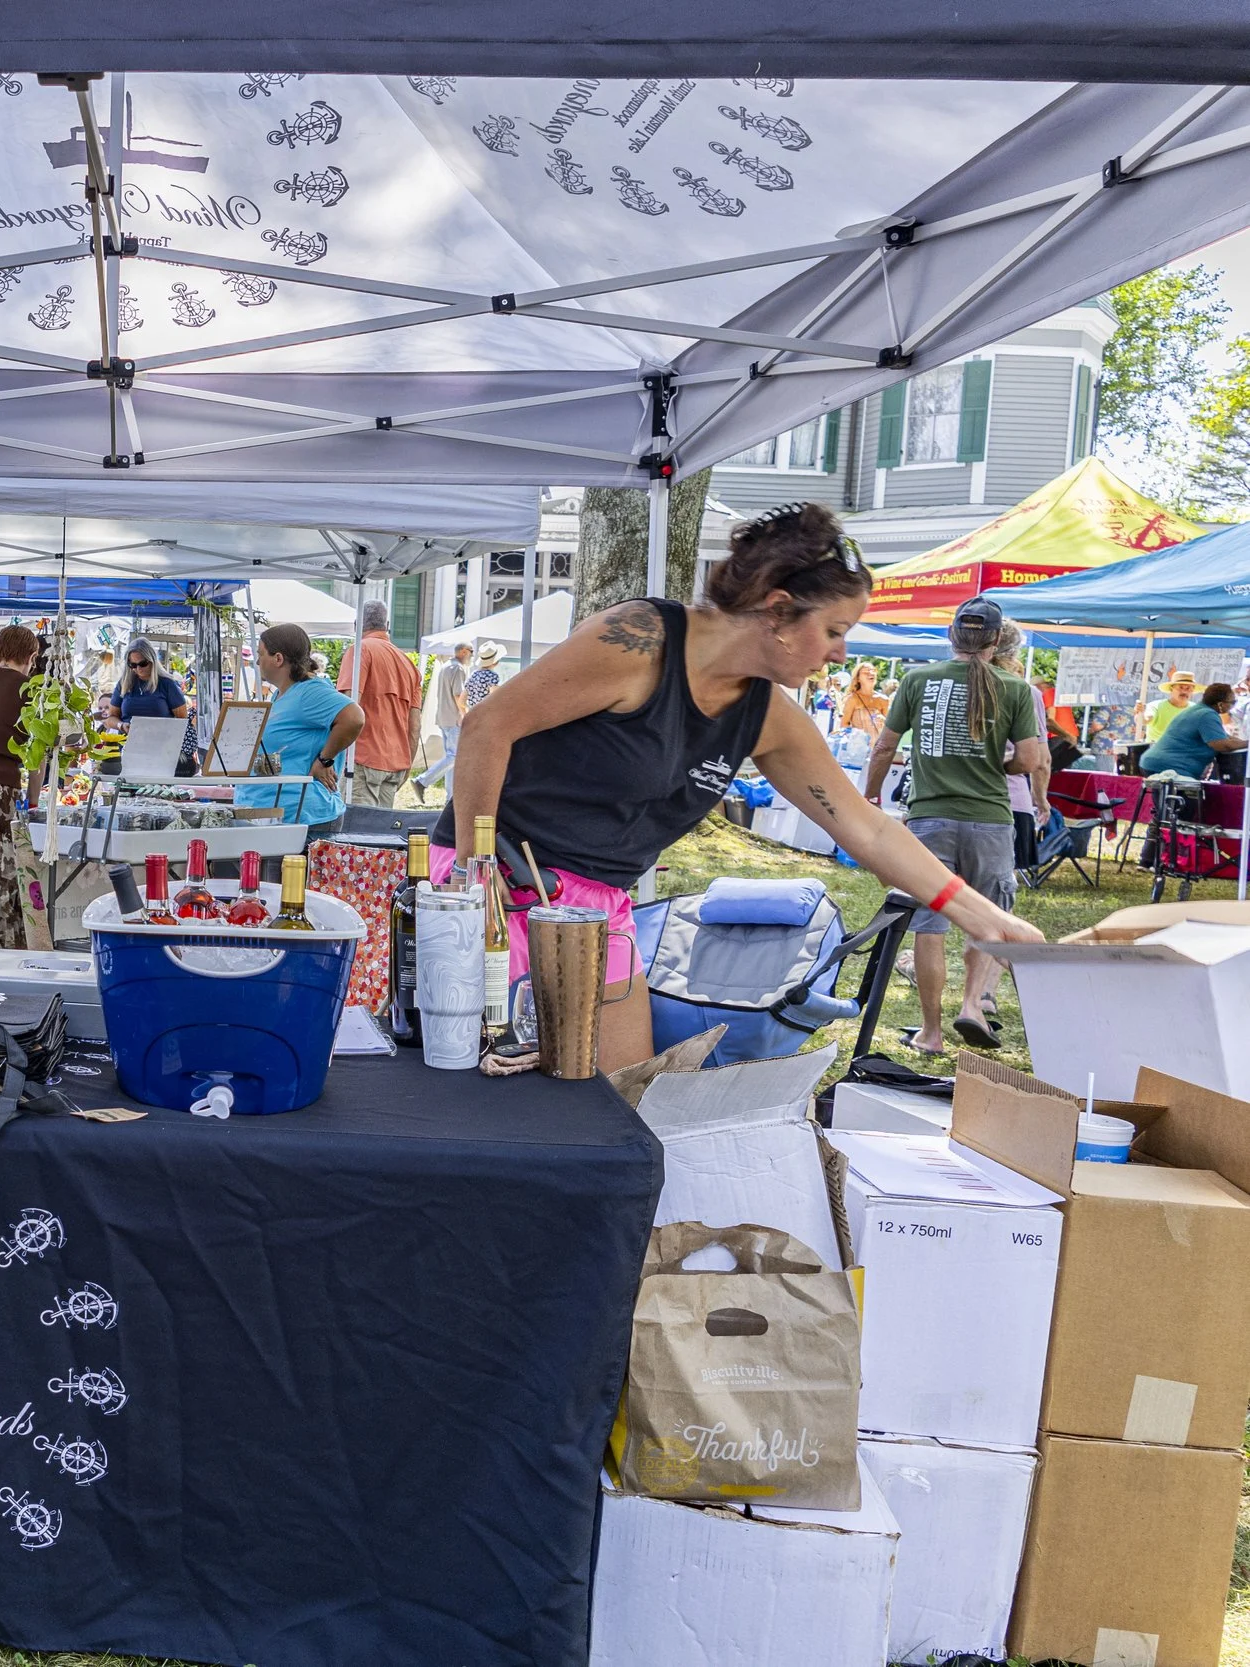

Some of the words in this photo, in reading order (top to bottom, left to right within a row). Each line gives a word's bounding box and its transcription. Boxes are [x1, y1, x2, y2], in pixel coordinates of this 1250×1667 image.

[939, 568, 971, 586] Festival
[1000, 569, 1049, 584] Home
[923, 679, 941, 703] LIST
[921, 705, 934, 726] TAP
[920, 728, 932, 756] 2023
[934, 713, 945, 752] TRAILBLAZERS
[878, 1221, 894, 1233] 12
[898, 1225, 906, 1234] x
[910, 1224, 952, 1238] 750ml
[1012, 1232, 1043, 1246] W65
[701, 1363, 781, 1382] Biscuitville
[681, 1421, 820, 1472] Thankful
